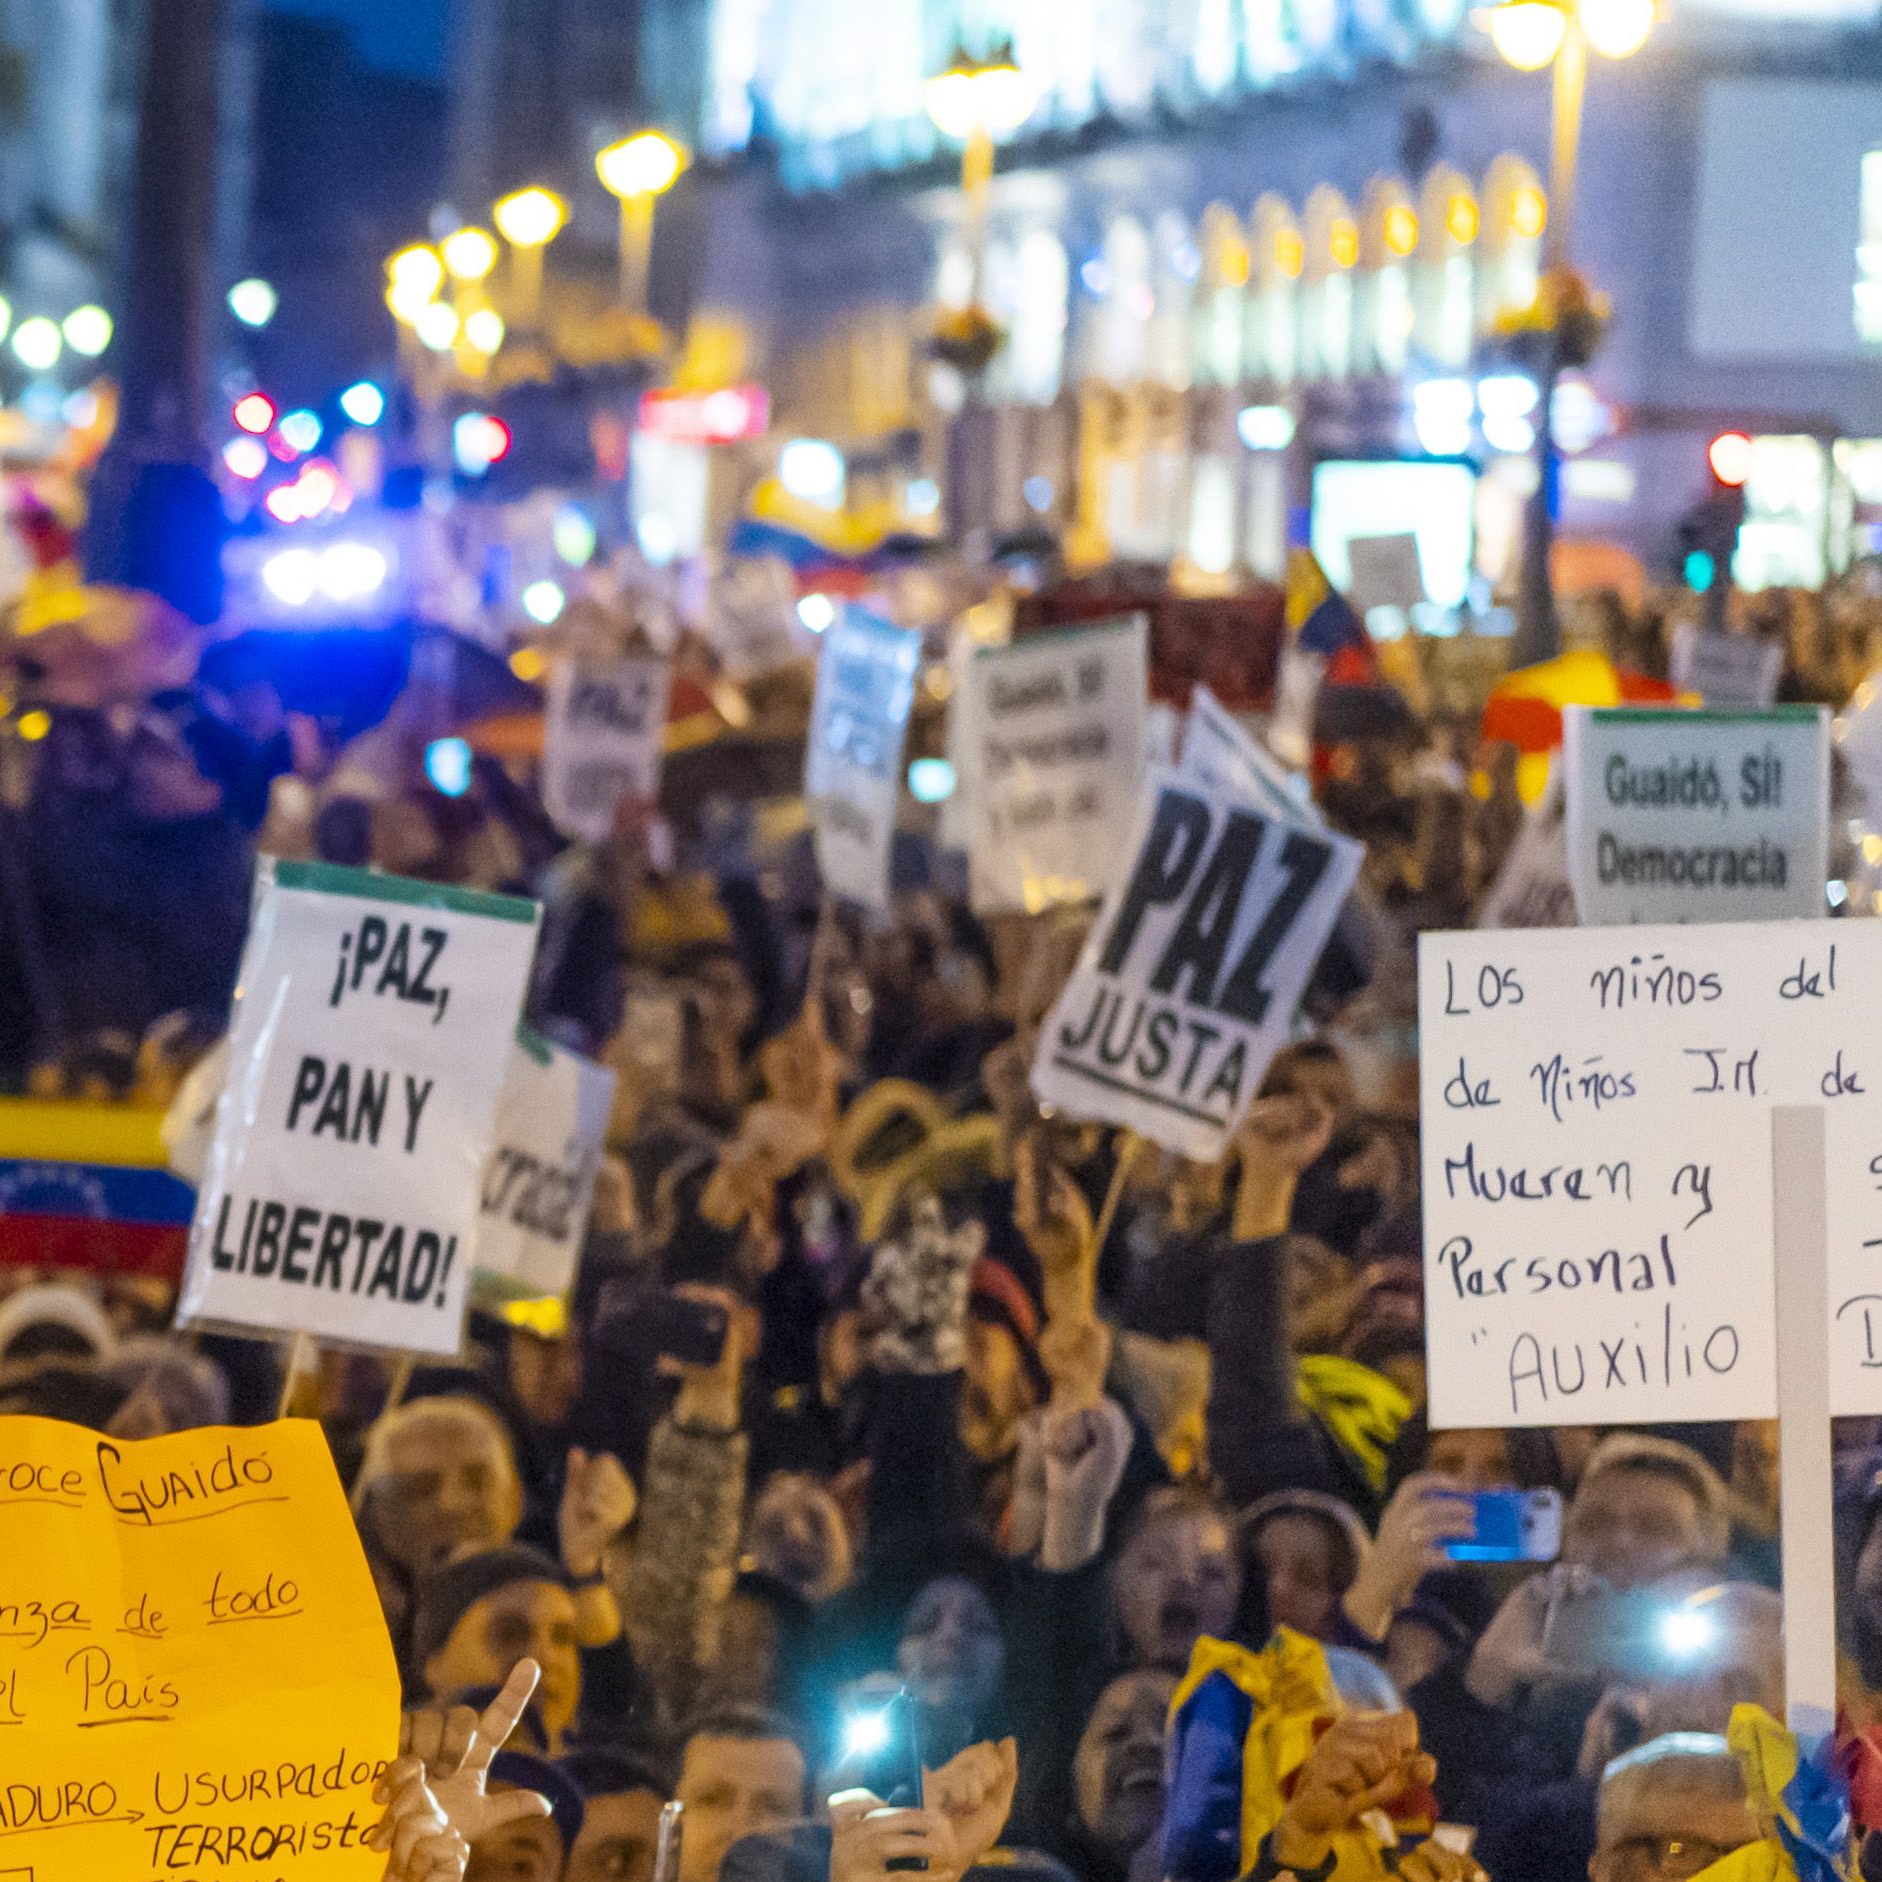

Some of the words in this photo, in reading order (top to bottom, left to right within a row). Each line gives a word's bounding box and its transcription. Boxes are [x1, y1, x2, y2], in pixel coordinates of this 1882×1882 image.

[1604, 751, 1730, 816] Guaidó,
[1596, 826, 1788, 890] Democracia
[1099, 788, 1333, 1026] PAZ
[330, 914, 453, 1026] ¡PAZ,
[1060, 985, 1256, 1101] JUSTA
[286, 1056, 391, 1147] PAN
[405, 1076, 436, 1154] Y
[1443, 1057, 1502, 1109] de
[1820, 1049, 1866, 1096] de
[1671, 1164, 1714, 1231] y
[210, 1194, 458, 1308] LIBERTAD!
[123, 1592, 169, 1635] de
[202, 1571, 300, 1618] todo
[65, 1645, 180, 1714] País
